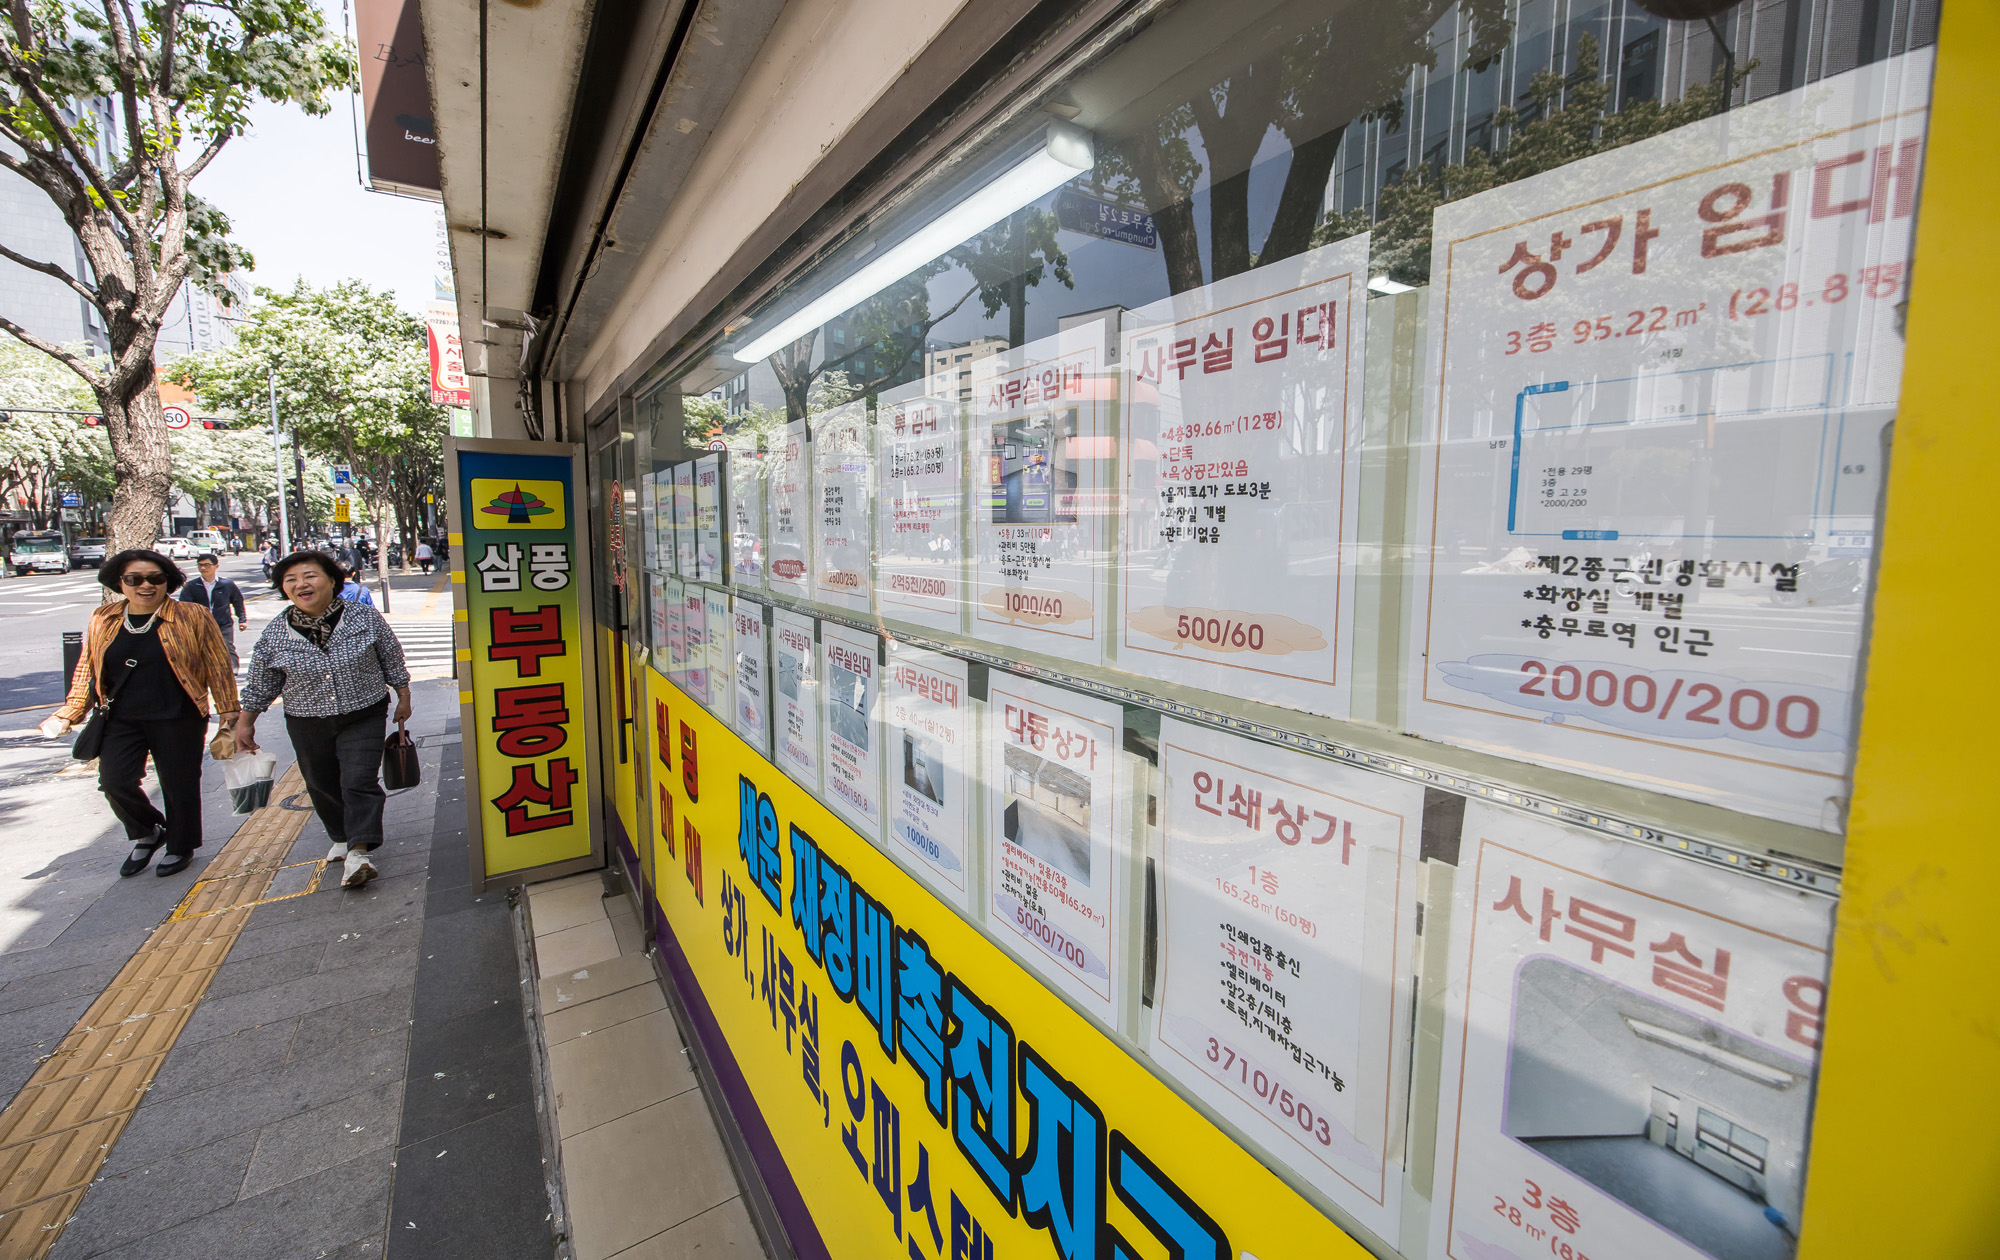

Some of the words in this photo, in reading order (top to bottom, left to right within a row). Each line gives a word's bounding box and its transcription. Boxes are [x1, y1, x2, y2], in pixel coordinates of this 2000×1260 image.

[1498, 208, 1660, 300] 상가
[1698, 137, 1921, 258] 임대
[1136, 327, 1235, 386] 사무실
[1251, 299, 1338, 364] 임대
[1504, 322, 1556, 356] 3층
[988, 362, 1082, 411] 사무실임대
[165, 413, 184, 423] 50
[911, 406, 937, 435] 임대
[1223, 481, 1272, 500] 도보3분
[1842, 464, 1865, 475] 6.9
[1203, 505, 1226, 522] 개별
[1572, 488, 1588, 497] 2.9
[473, 542, 572, 592] 삼풍
[1005, 592, 1063, 619] 1000/60
[1176, 614, 1264, 651] 500/60
[1654, 625, 1714, 657] 인근
[828, 643, 872, 679] 사무실임대
[894, 665, 958, 710] 사무실임대
[1519, 659, 1820, 739] 2000/200
[488, 604, 579, 838] 부동산
[1004, 703, 1098, 771] 다동상가
[655, 697, 699, 804] 빌딩
[833, 776, 868, 811] 3000/150.8
[1192, 770, 1357, 866] 인쇄상가
[659, 780, 704, 909] 매매
[738, 773, 783, 917] 세운
[906, 825, 940, 859] 1000/60
[1248, 865, 1280, 896] 1층
[1016, 905, 1085, 969] 5000/700
[1275, 905, 1317, 939] (50평)
[1492, 874, 1731, 1013] 사무실
[721, 868, 755, 1001] 상가,
[760, 924, 830, 1129] 사무실,
[1206, 1036, 1331, 1148] 3710/503
[1522, 1178, 1581, 1235] 3층
[1551, 1235, 1591, 1260] (8
